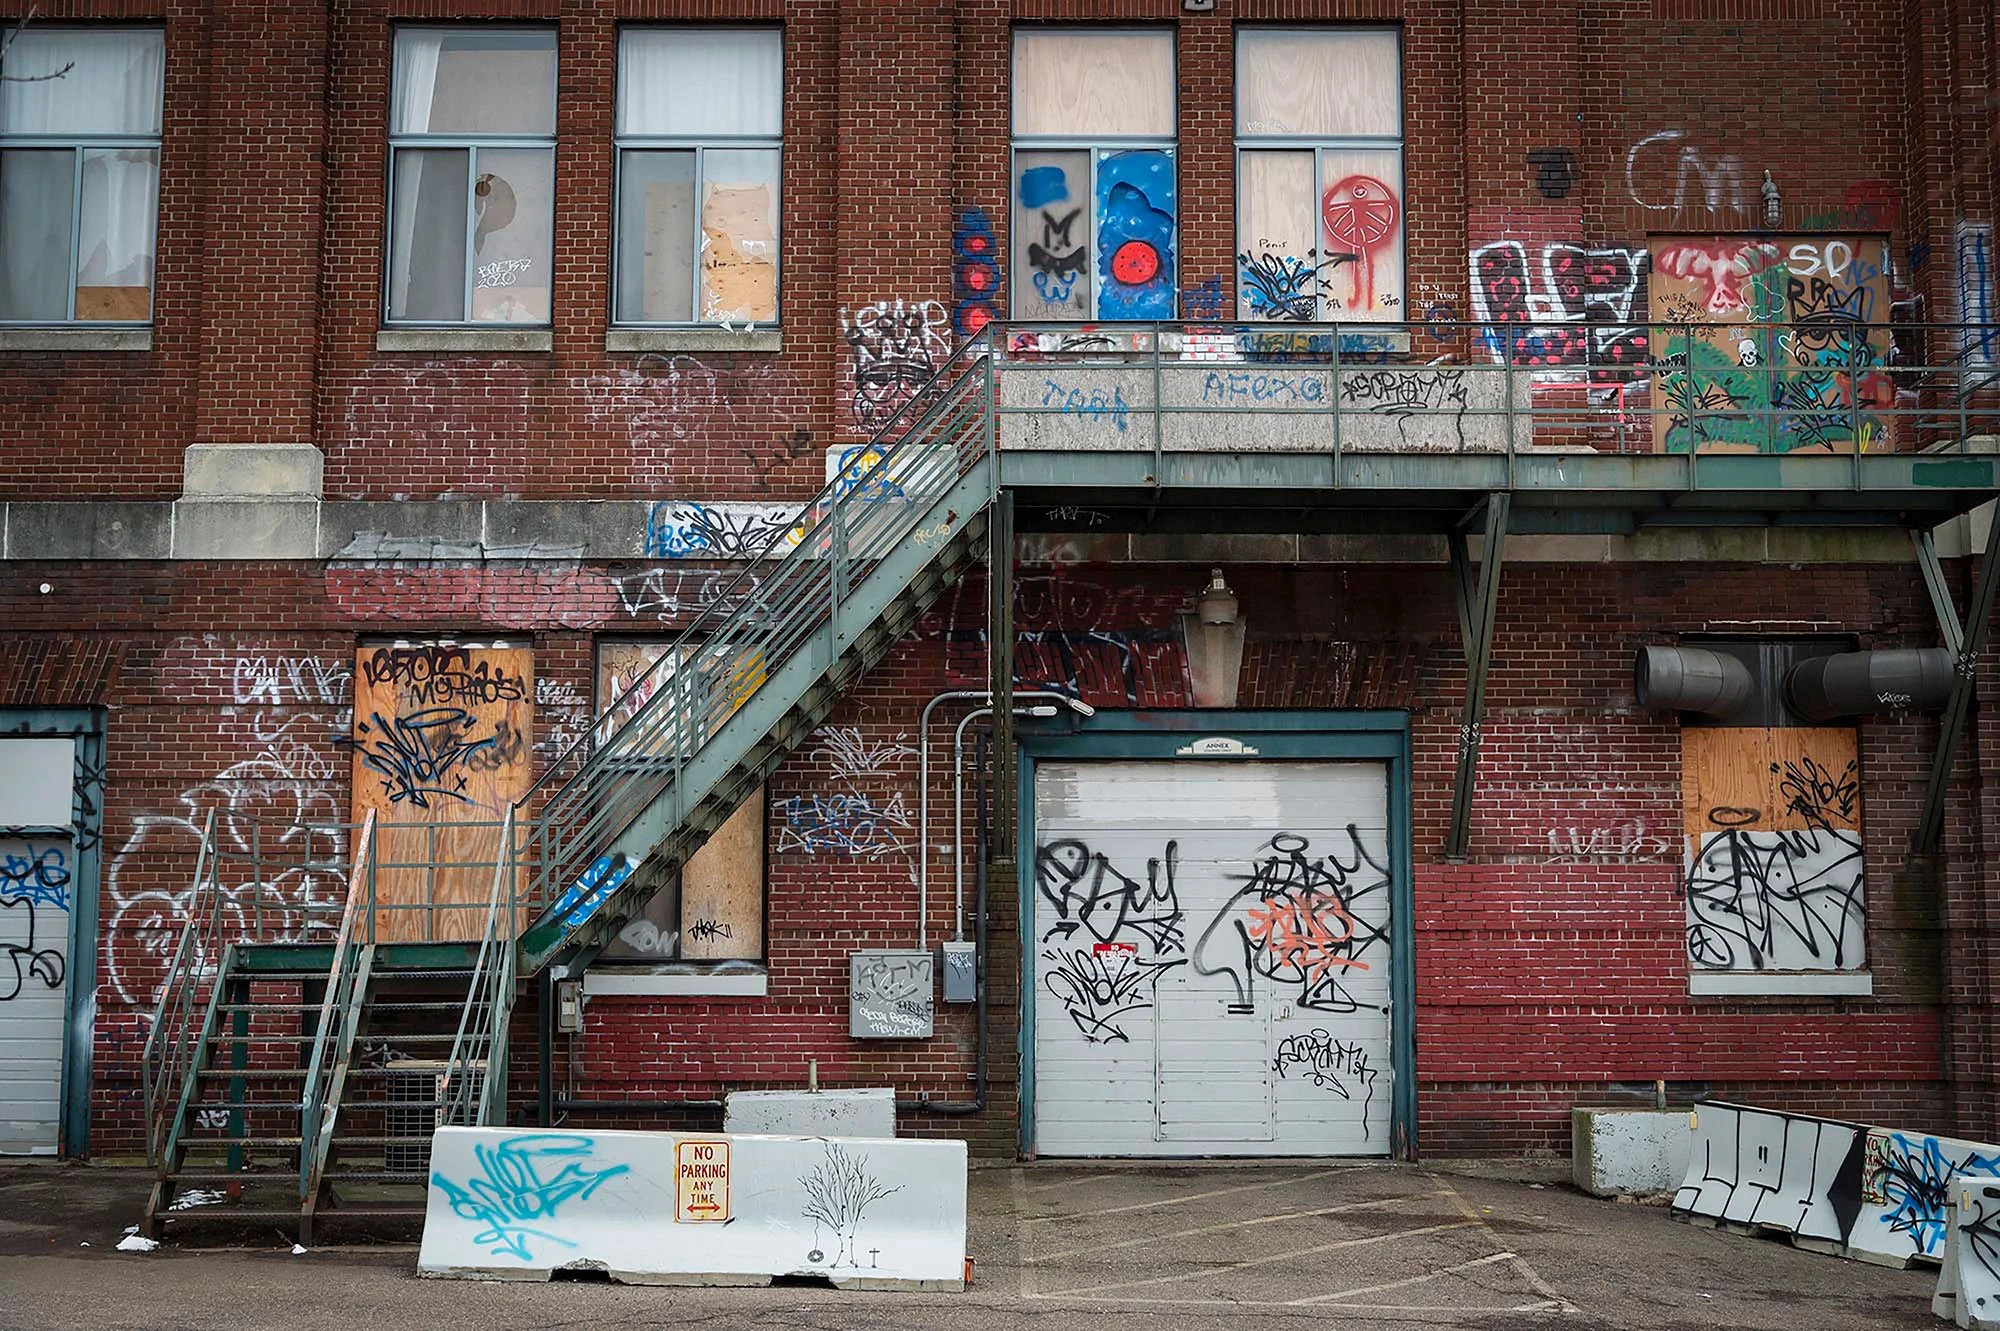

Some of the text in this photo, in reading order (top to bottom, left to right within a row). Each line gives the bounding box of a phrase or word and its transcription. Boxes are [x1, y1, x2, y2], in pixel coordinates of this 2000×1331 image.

[694, 1146, 714, 1160] NO
[681, 1164, 726, 1178] PARKING
[693, 1181, 714, 1191] ANY
[690, 1193, 715, 1204] TIME
